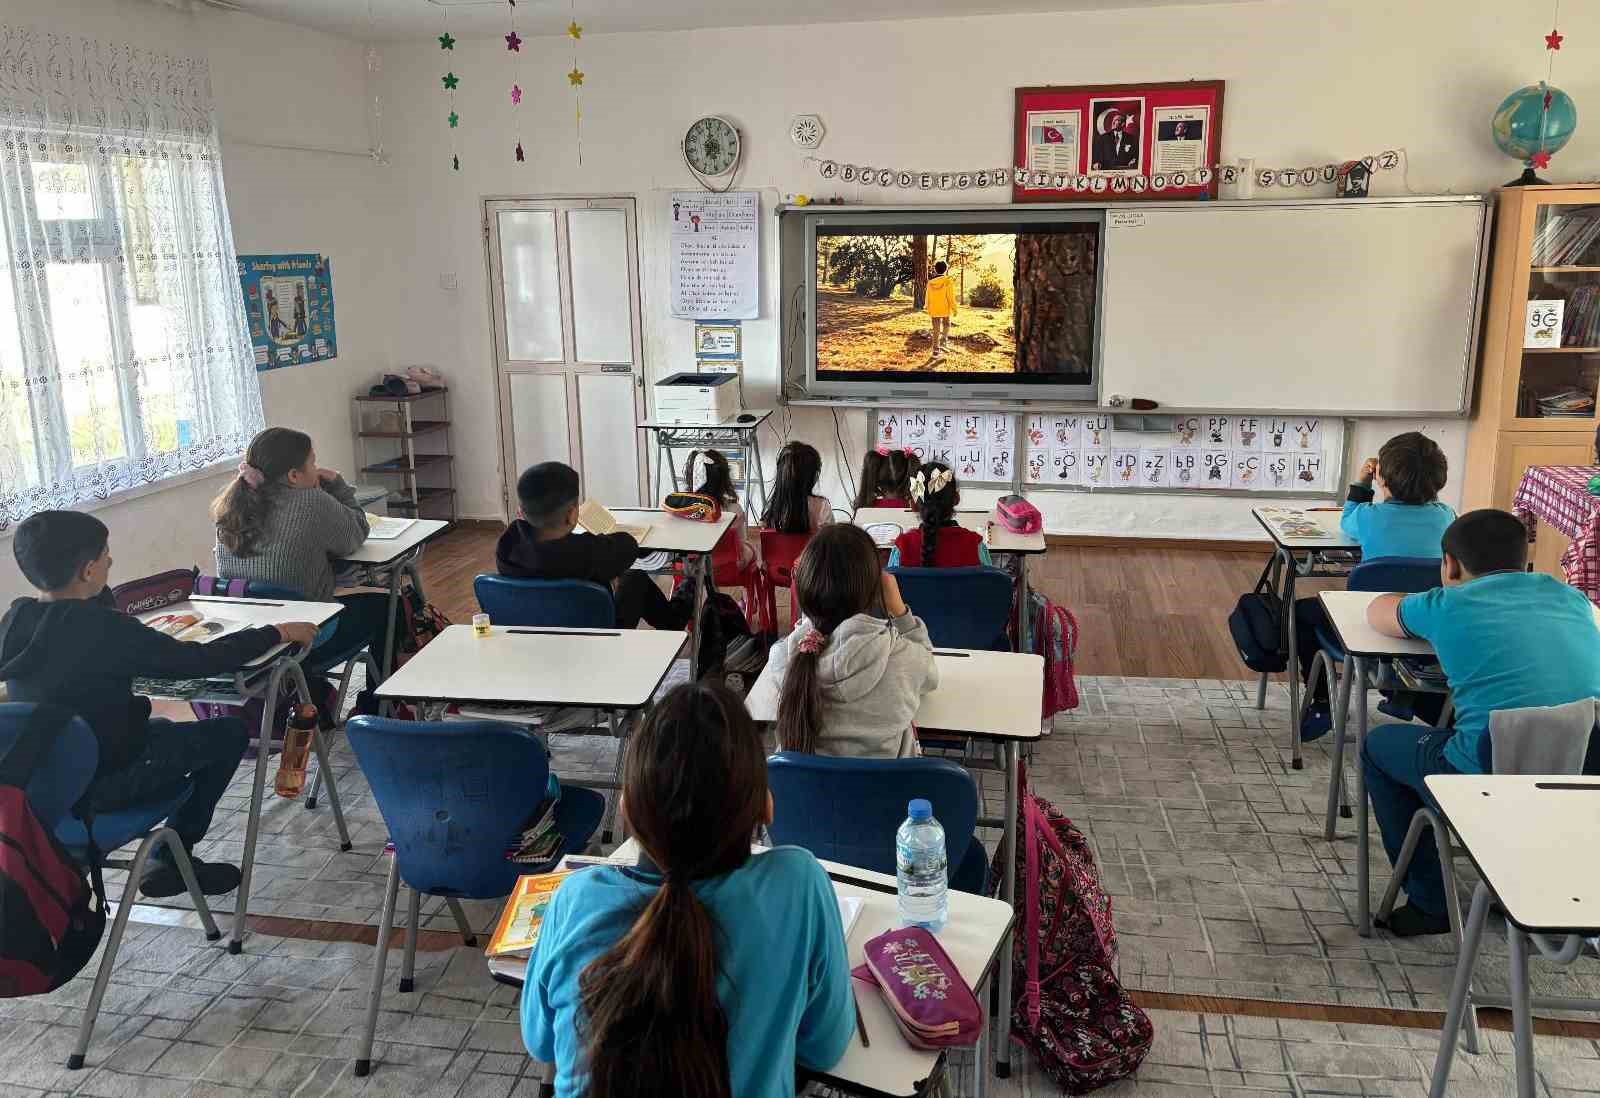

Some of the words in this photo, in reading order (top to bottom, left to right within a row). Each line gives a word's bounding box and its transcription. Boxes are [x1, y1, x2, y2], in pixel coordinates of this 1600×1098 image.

[824, 164, 832, 175] A
[844, 167, 853, 179] B
[901, 174, 910, 186] D
[921, 175, 930, 187] E
[941, 175, 950, 187] F
[958, 175, 967, 187] G
[995, 172, 1005, 183] H
[1056, 175, 1064, 187] J
[1076, 178, 1085, 189] K
[1094, 178, 1102, 190] L
[1113, 178, 1126, 190] M
[1134, 178, 1145, 190] N
[1154, 176, 1165, 188] O
[1199, 170, 1208, 182] P
[1224, 169, 1233, 182] R
[1284, 173, 1296, 185] T
[1304, 171, 1315, 183] U
[1384, 154, 1395, 168] Z
